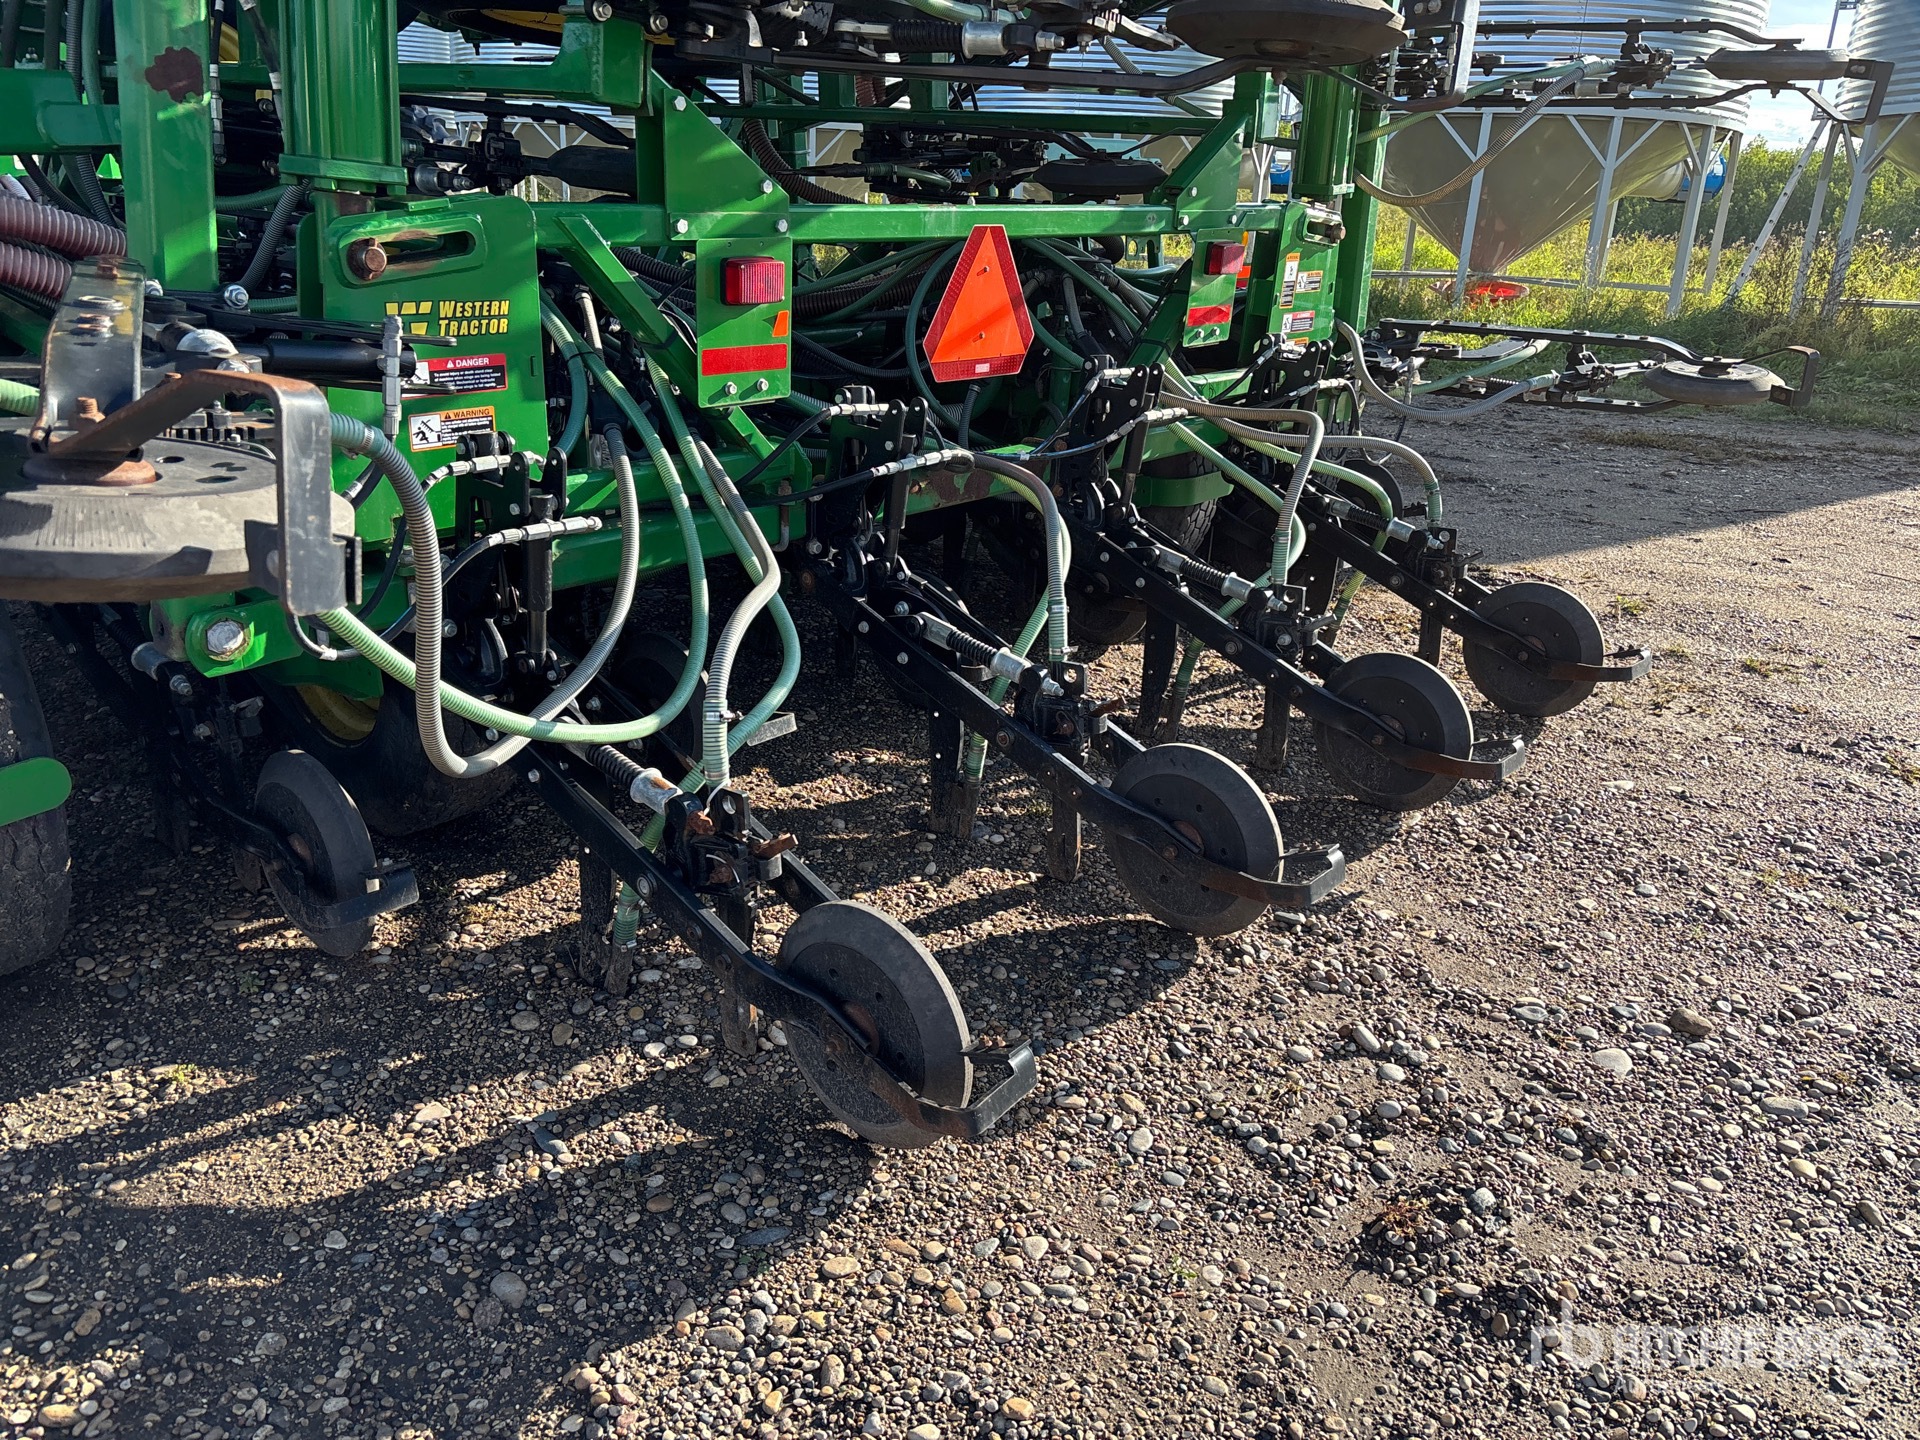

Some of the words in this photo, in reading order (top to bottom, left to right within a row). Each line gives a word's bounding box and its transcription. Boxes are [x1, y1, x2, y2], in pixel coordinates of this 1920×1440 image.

[439, 300, 510, 318] WESTERN
[438, 318, 509, 337] TRACTOR
[455, 357, 490, 367] DANGER
[453, 408, 490, 419] WARNING
